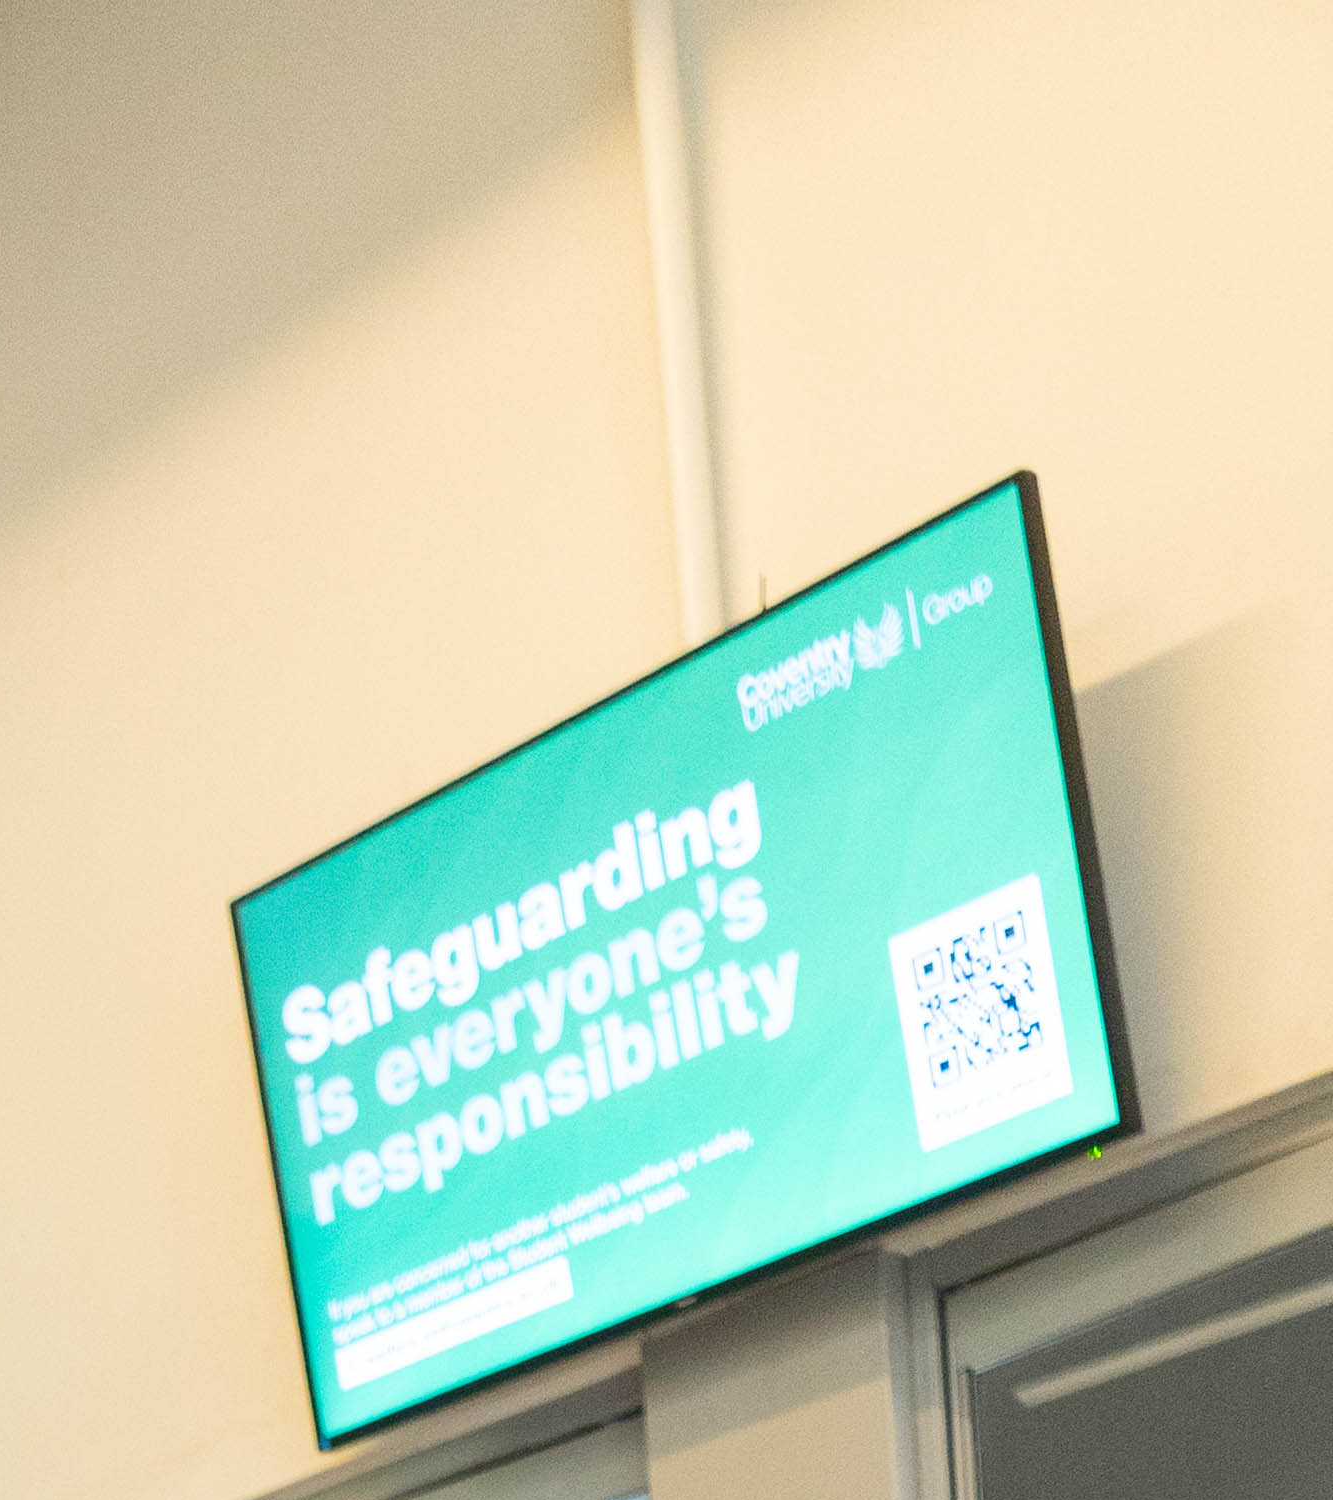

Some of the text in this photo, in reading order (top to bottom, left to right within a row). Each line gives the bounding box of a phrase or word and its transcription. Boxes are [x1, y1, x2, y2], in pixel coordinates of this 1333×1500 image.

[737, 573, 993, 707] Coventry Group
[743, 658, 854, 732] University
[281, 780, 761, 1063] Safeguarding
[294, 874, 768, 1147] is everyone's
[309, 950, 800, 1225] responsibility
[620, 1158, 679, 1196] welfare
[678, 1150, 698, 1172] or
